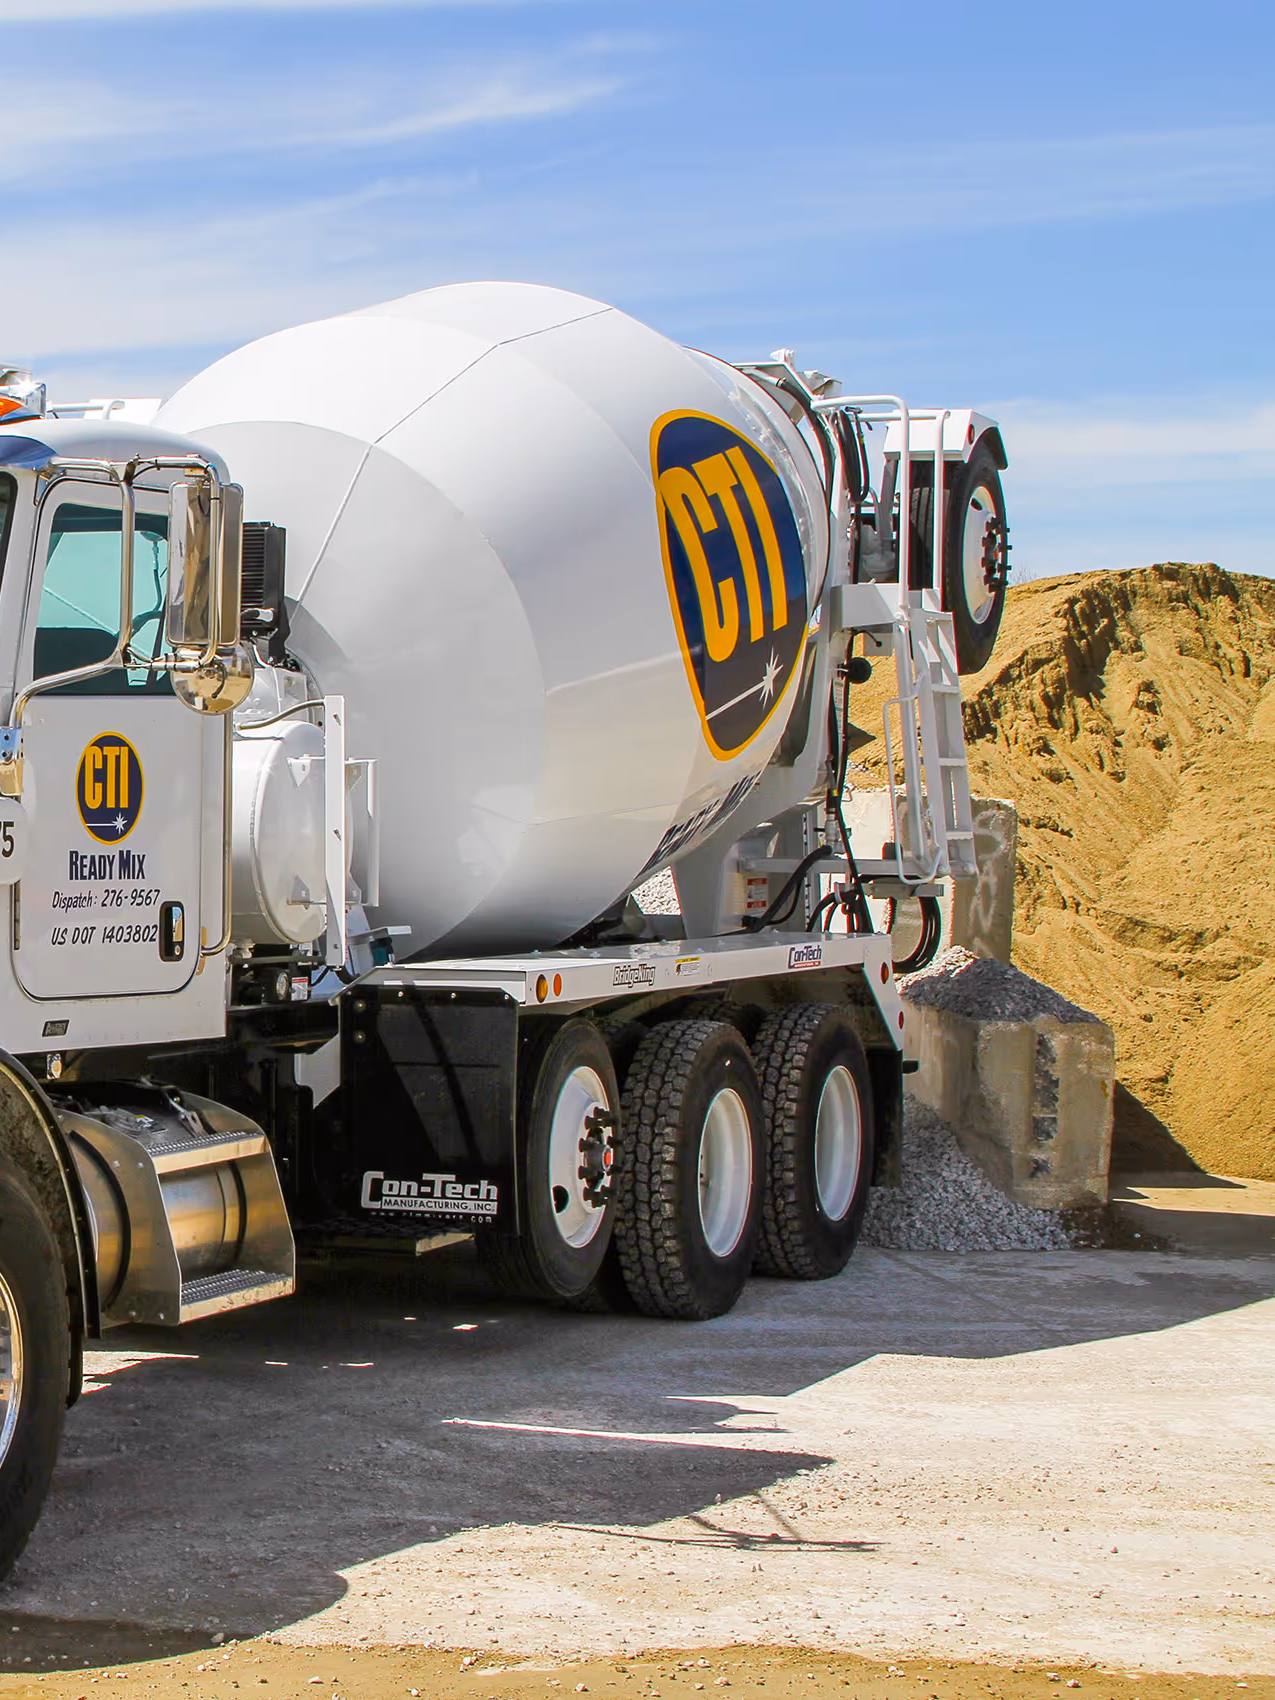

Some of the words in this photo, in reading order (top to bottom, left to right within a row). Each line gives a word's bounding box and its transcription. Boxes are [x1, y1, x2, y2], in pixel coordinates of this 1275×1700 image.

[658, 446, 787, 662] CTI
[84, 746, 129, 809] CTI
[69, 850, 115, 880] READY
[119, 849, 146, 880] MIX
[52, 890, 97, 913] Dispatch:
[101, 888, 160, 907] 276-9567
[51, 926, 68, 946] US
[72, 926, 96, 944] DOT
[102, 924, 158, 943] 1403802
[361, 1171, 498, 1208] Con-Tech
[474, 1203, 495, 1211] INC.
